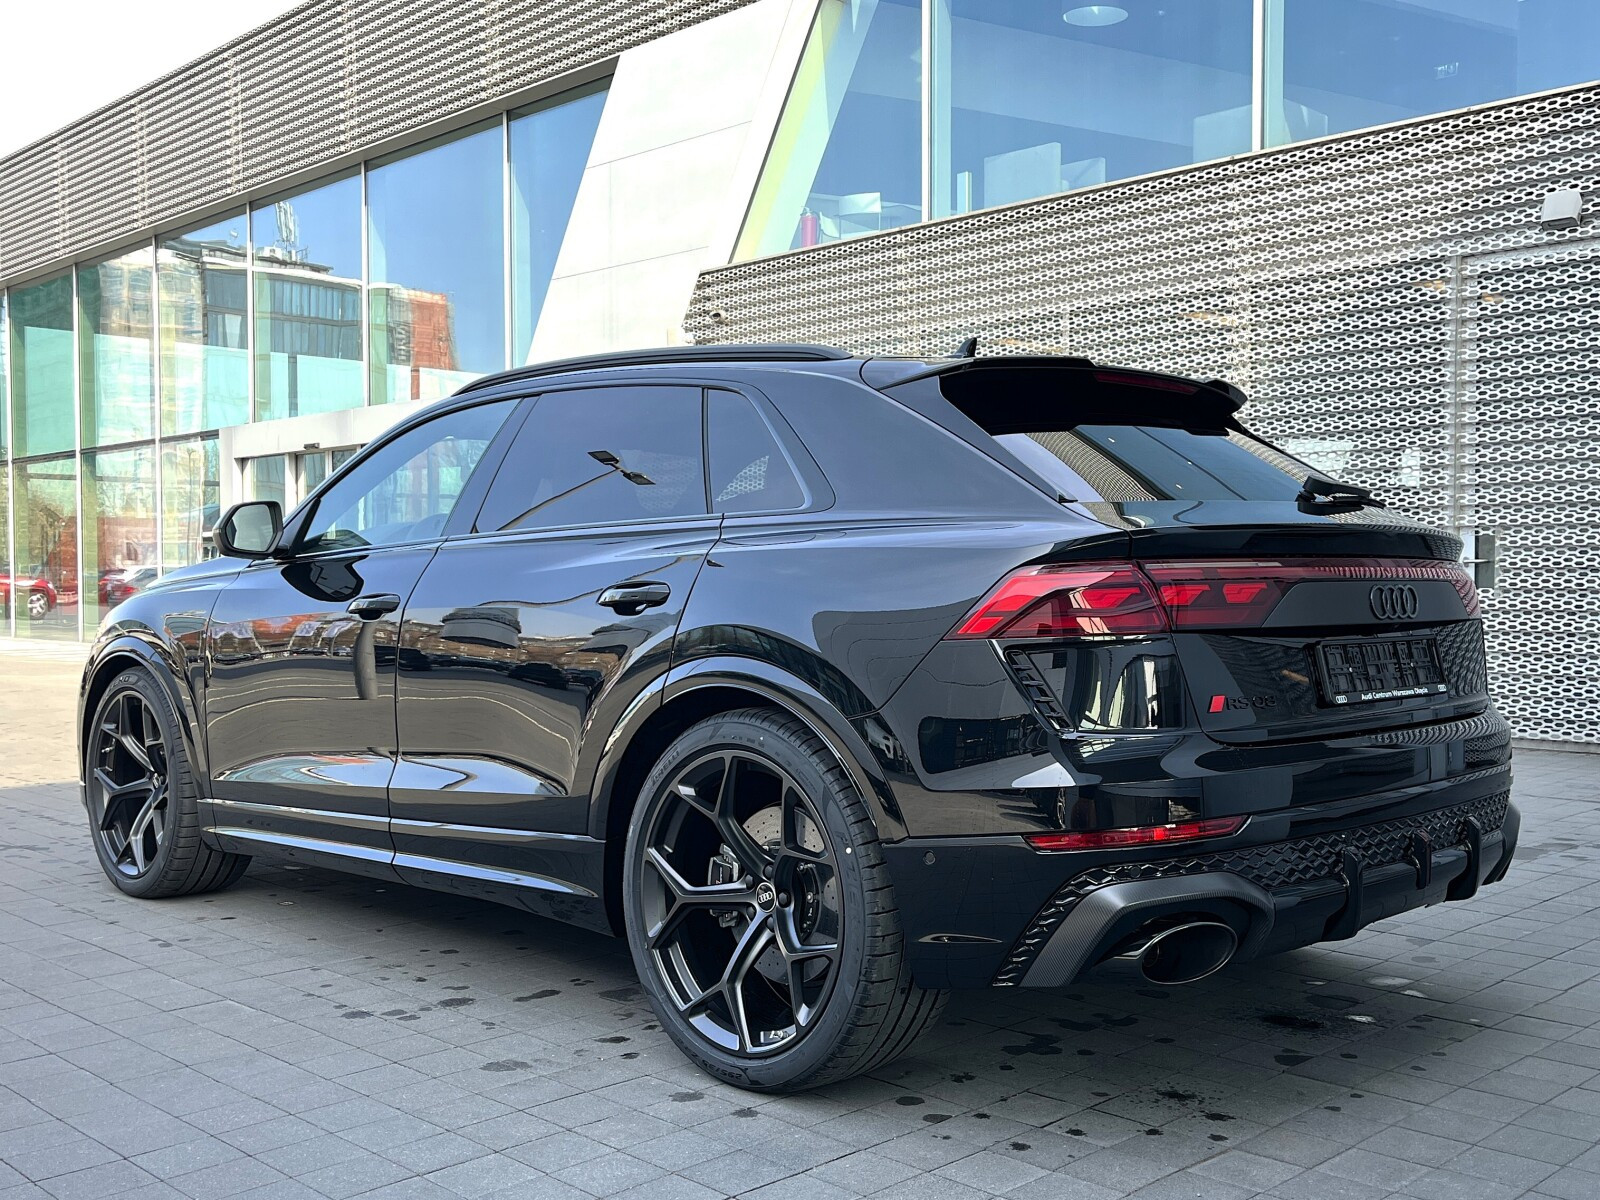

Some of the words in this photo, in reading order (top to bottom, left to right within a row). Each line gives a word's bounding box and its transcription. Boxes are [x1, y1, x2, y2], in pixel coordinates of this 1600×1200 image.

[1361, 692, 1373, 701] Audi
[1372, 691, 1393, 699] Centrum
[1391, 689, 1415, 697] Warszawa
[1225, 695, 1250, 711] RS
[1251, 695, 1278, 710] Q8
